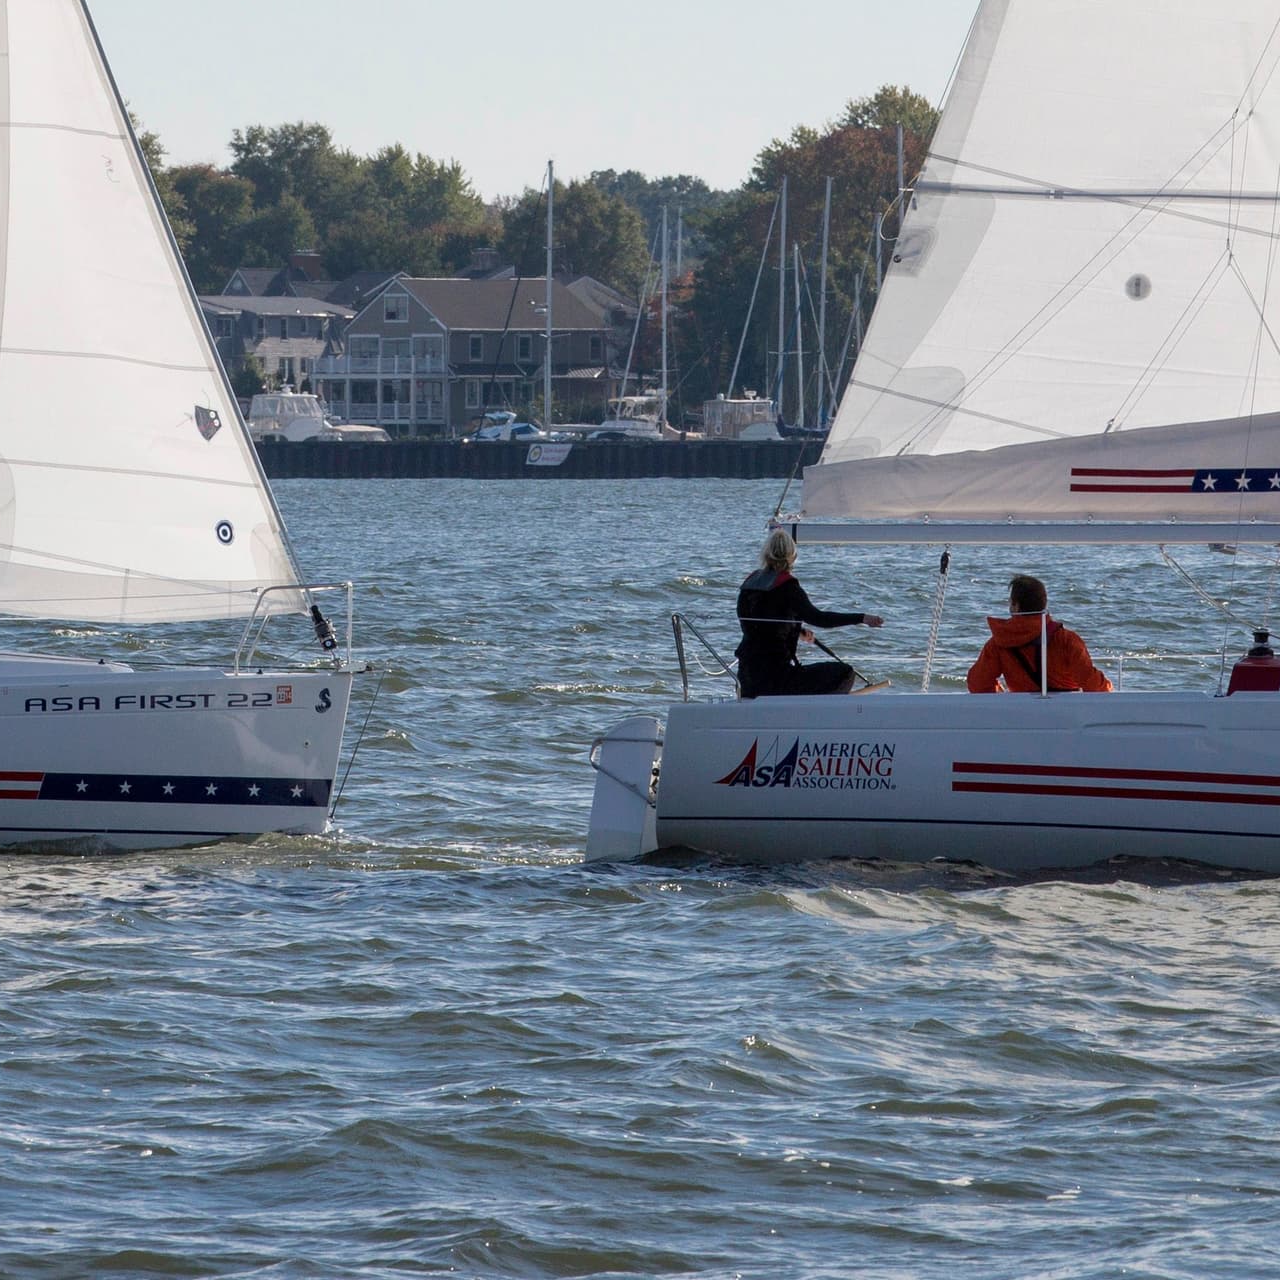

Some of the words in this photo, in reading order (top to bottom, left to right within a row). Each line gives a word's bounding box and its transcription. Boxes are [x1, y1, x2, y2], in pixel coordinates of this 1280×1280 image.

[25, 697, 100, 713] ASA
[115, 694, 215, 710] FIRST
[228, 693, 273, 708] 22
[800, 743, 896, 758] AMERICAN
[729, 765, 793, 788] ASA
[796, 757, 892, 777] SAILING
